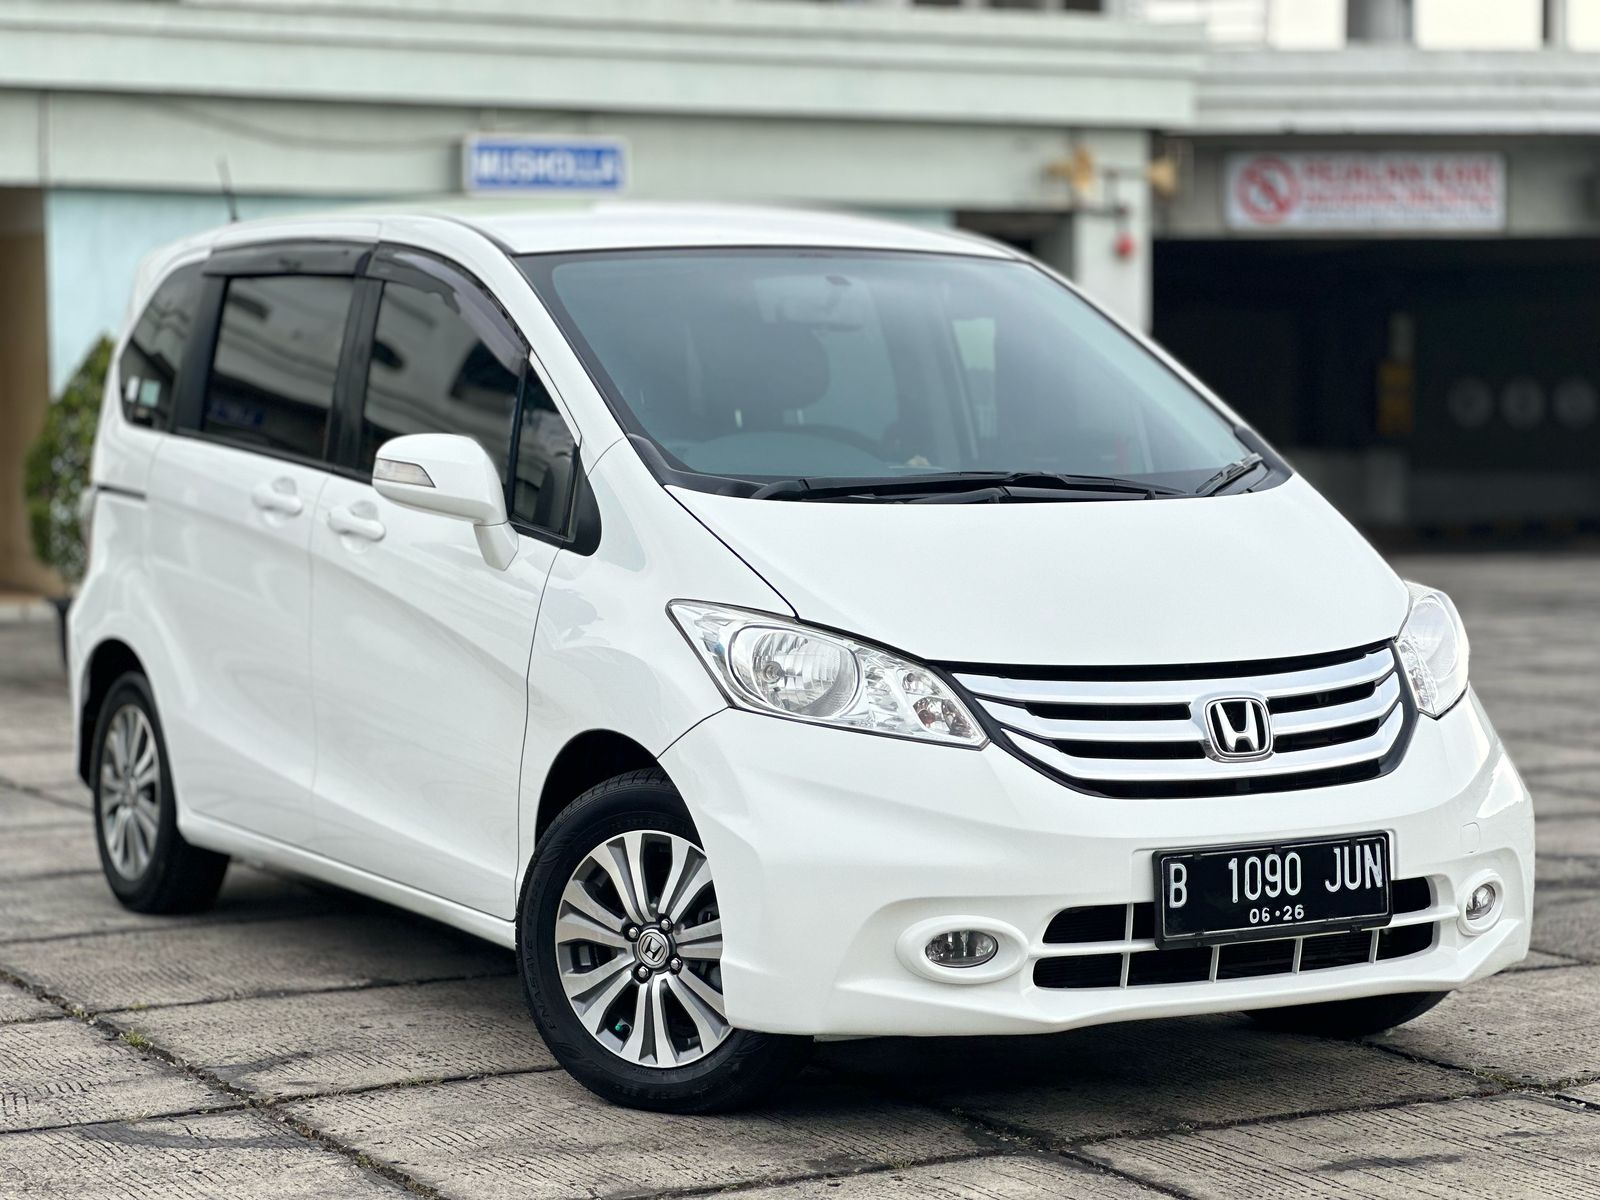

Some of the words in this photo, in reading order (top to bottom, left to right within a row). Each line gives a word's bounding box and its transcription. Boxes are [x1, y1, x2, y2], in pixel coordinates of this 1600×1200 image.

[1169, 863, 1187, 909] B
[1228, 852, 1302, 904] 1090
[1325, 843, 1383, 893] JUN
